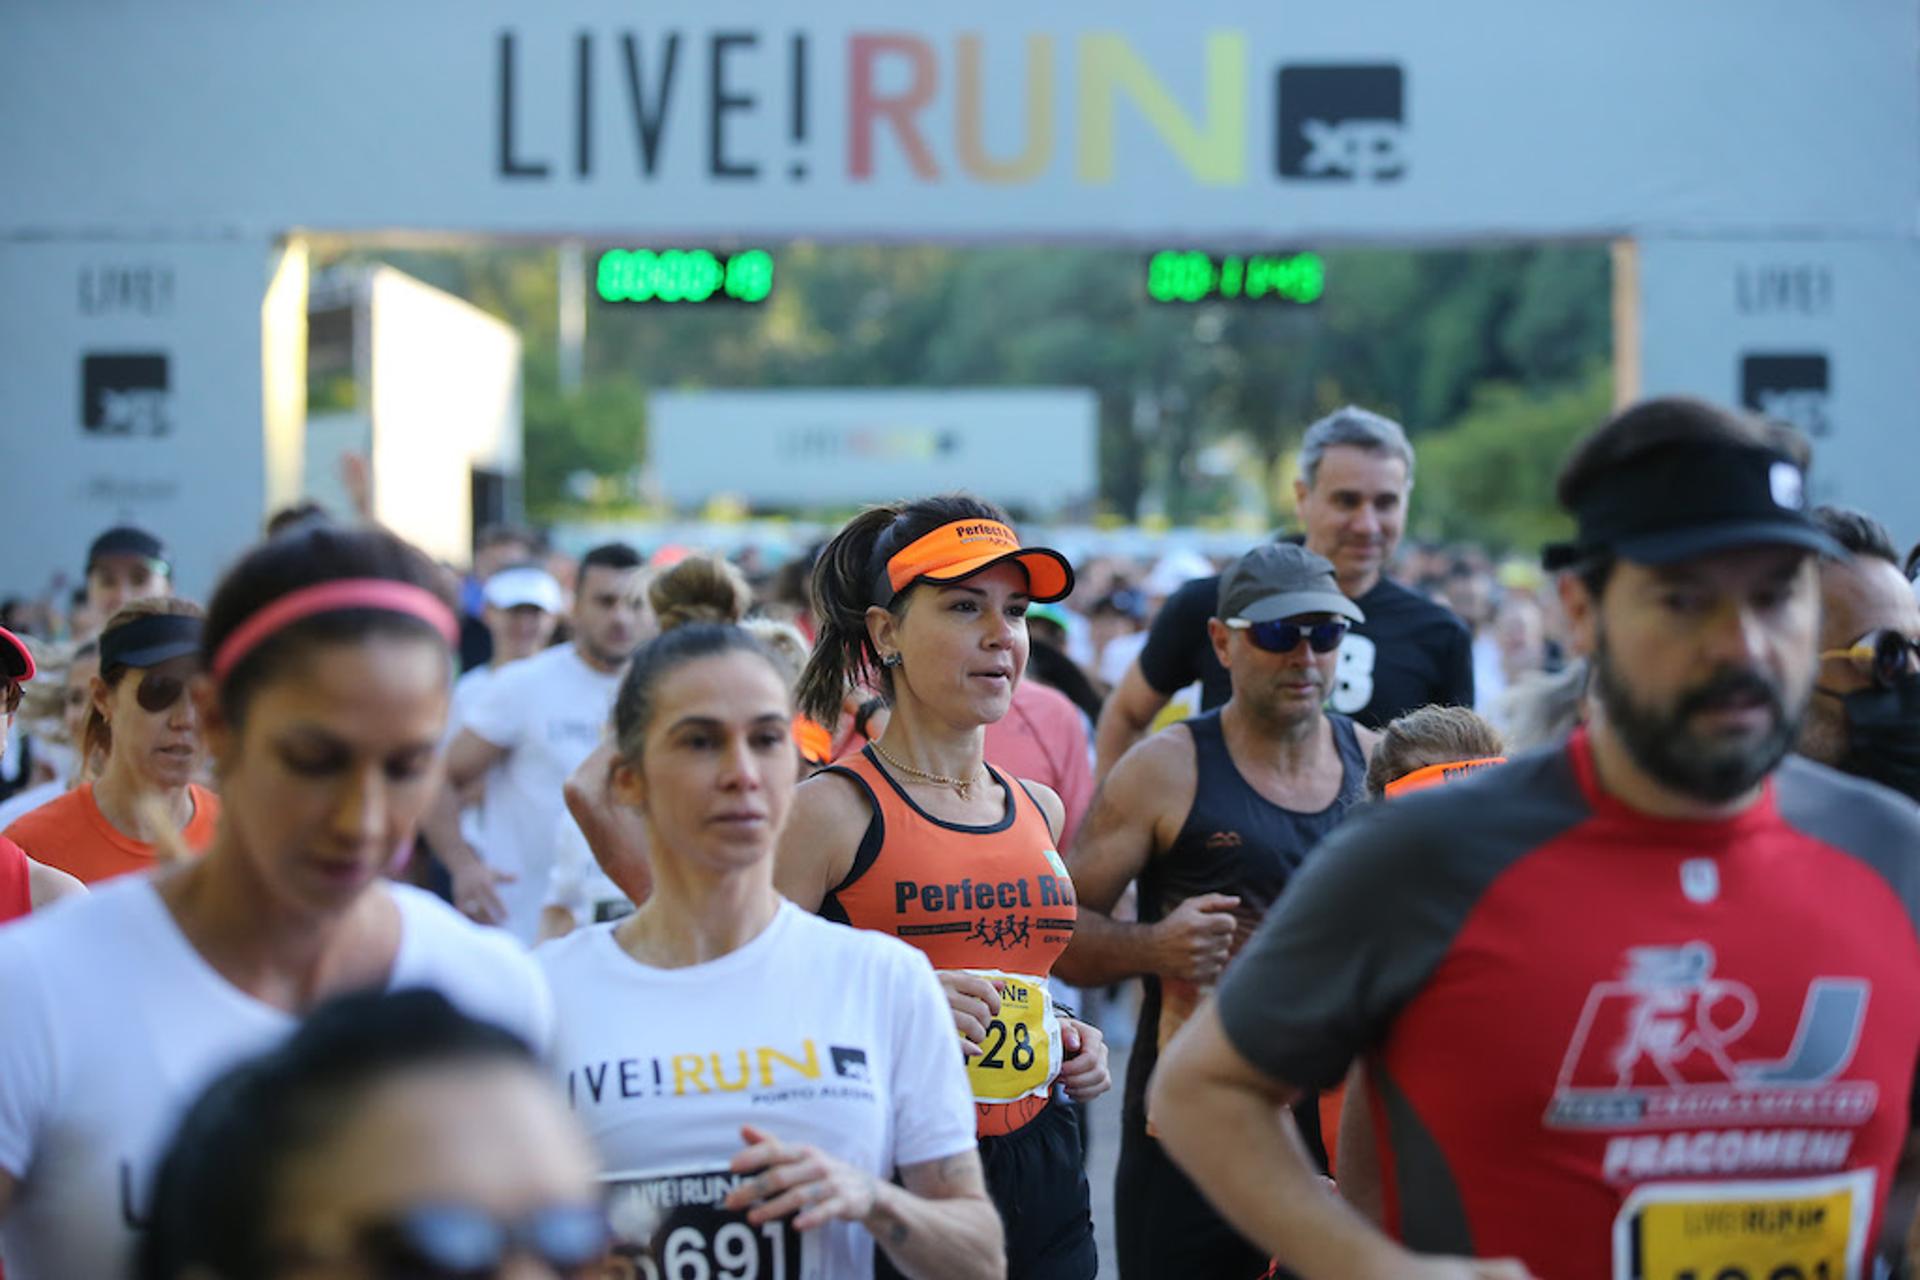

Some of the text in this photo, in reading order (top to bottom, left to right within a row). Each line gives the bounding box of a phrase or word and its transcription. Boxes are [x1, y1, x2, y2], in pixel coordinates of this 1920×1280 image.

[895, 877, 1032, 914] Perfect
[964, 1019, 1036, 1072] 28
[634, 1221, 788, 1280] 691
